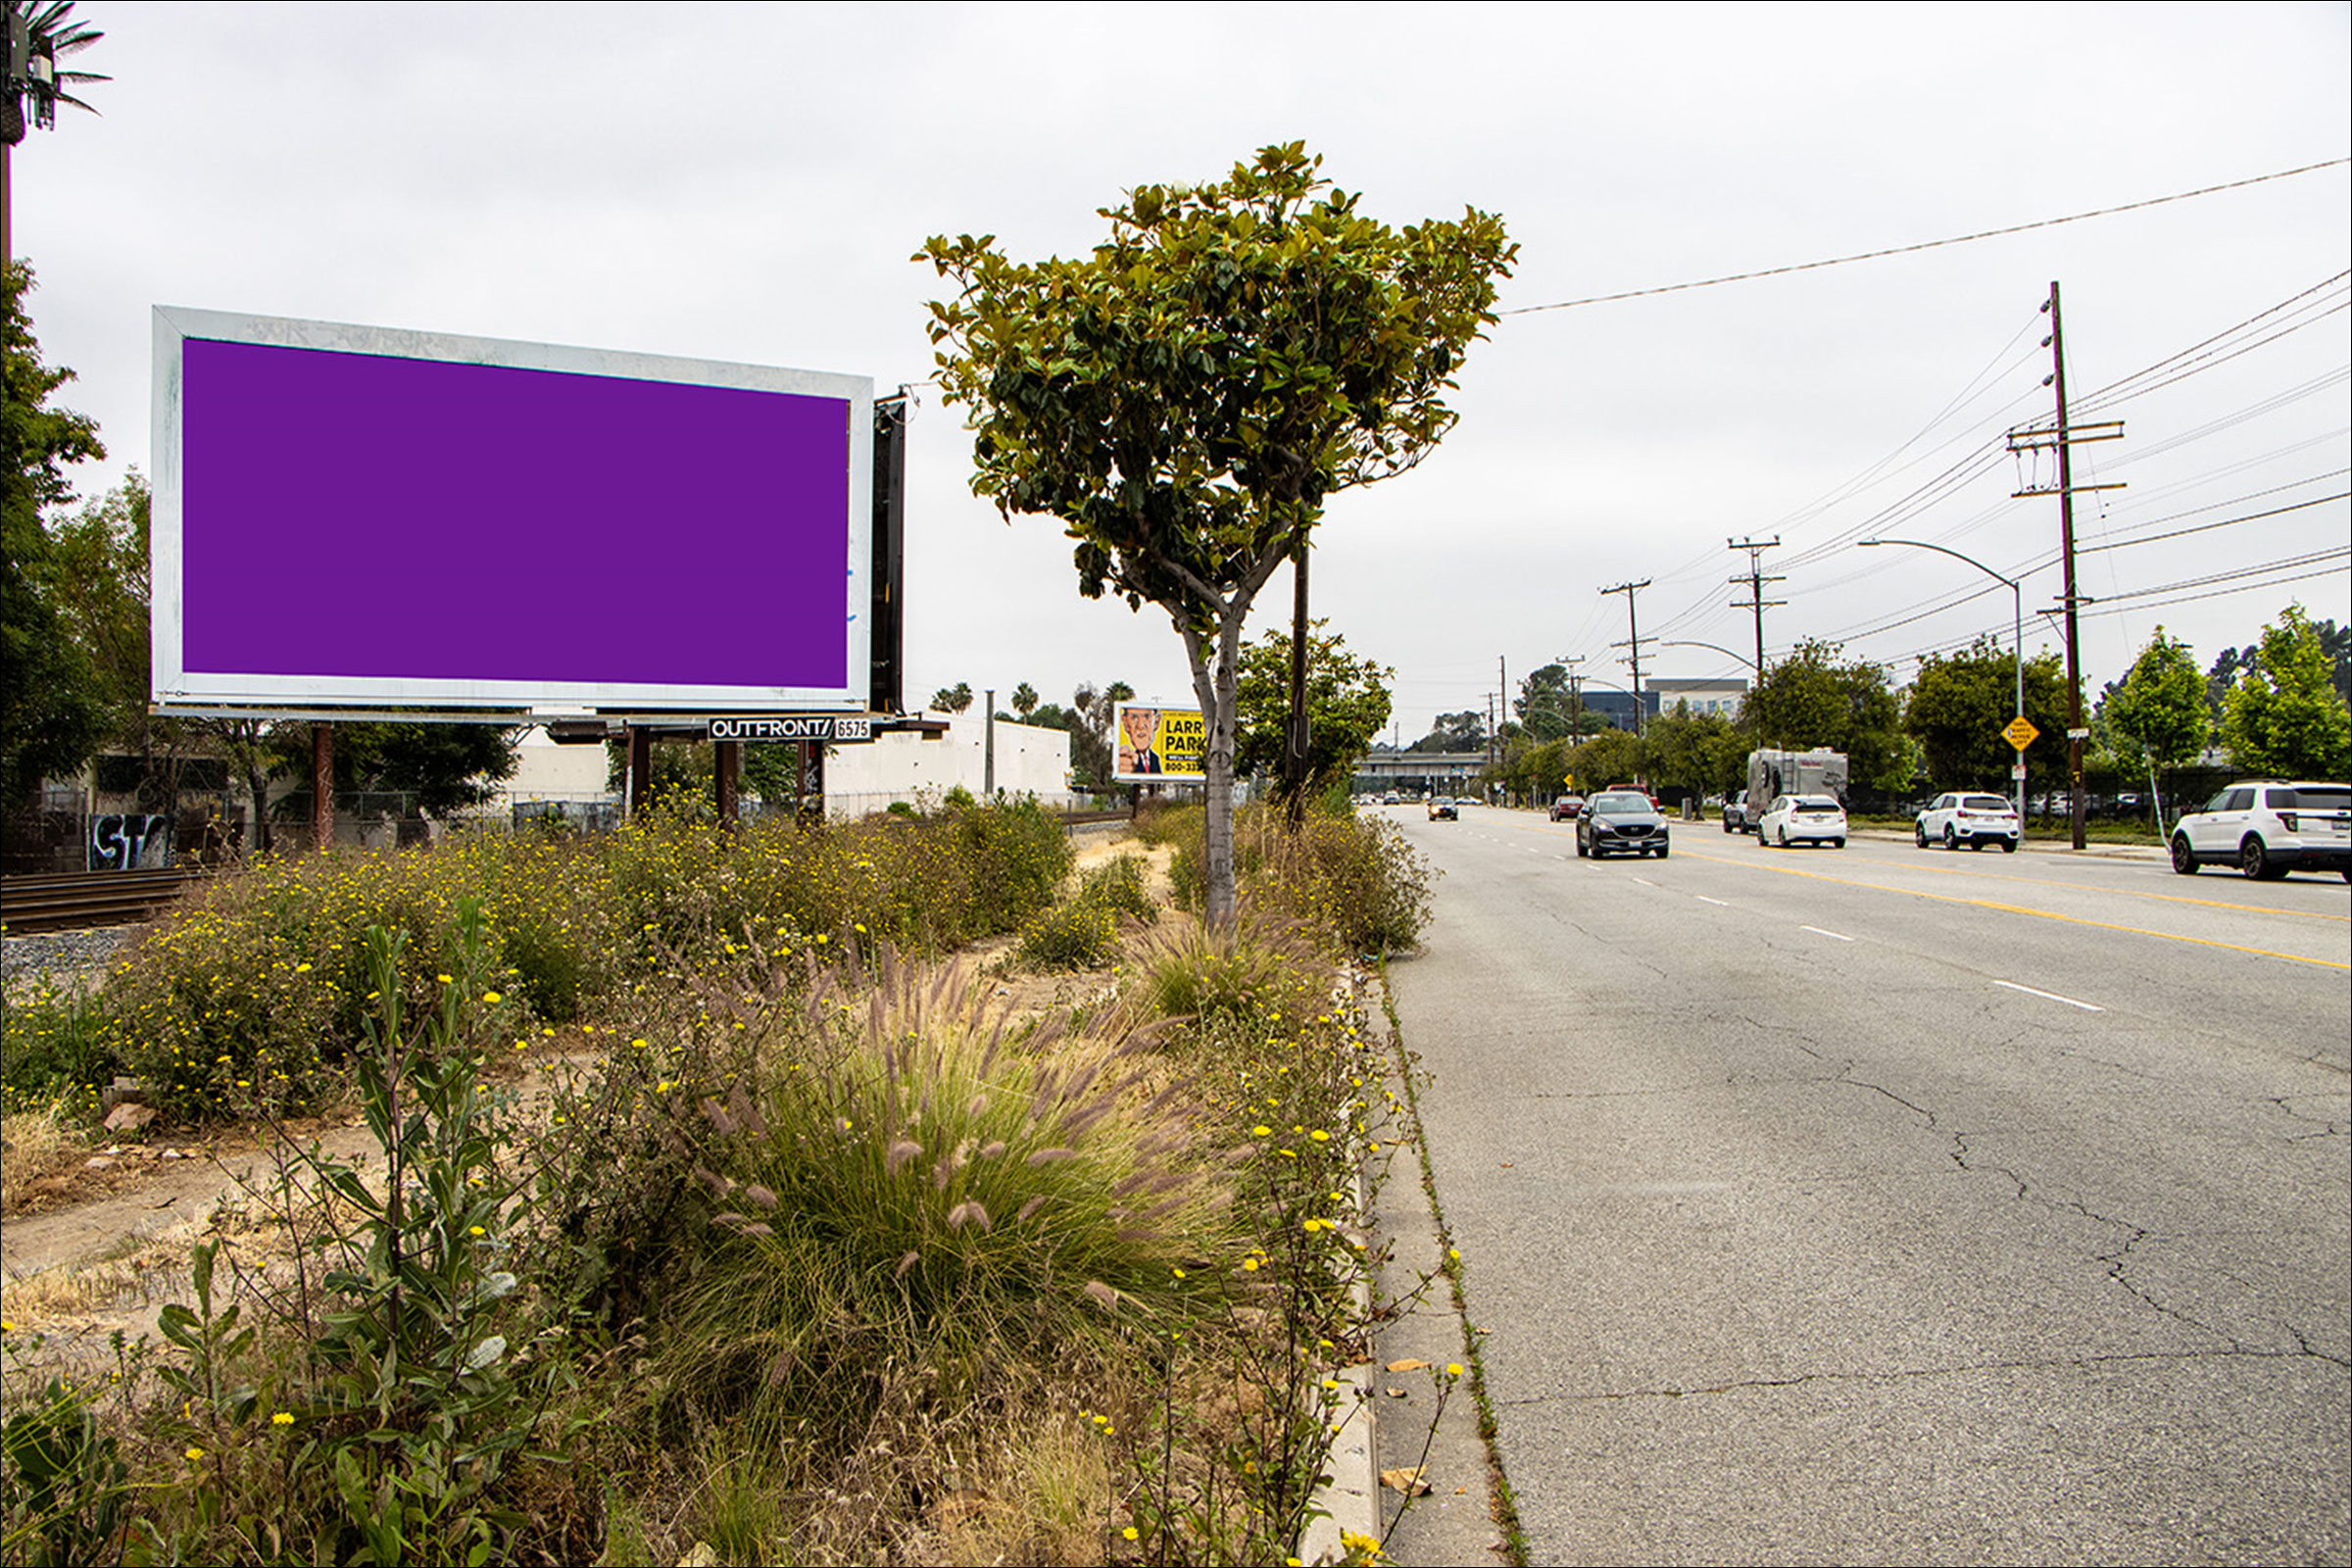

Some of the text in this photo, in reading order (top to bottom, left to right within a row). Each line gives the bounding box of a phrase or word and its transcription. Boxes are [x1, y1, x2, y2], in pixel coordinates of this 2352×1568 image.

[838, 720, 869, 737] 6575
[1166, 720, 1202, 734] LARR
[1166, 736, 1206, 751] PARK
